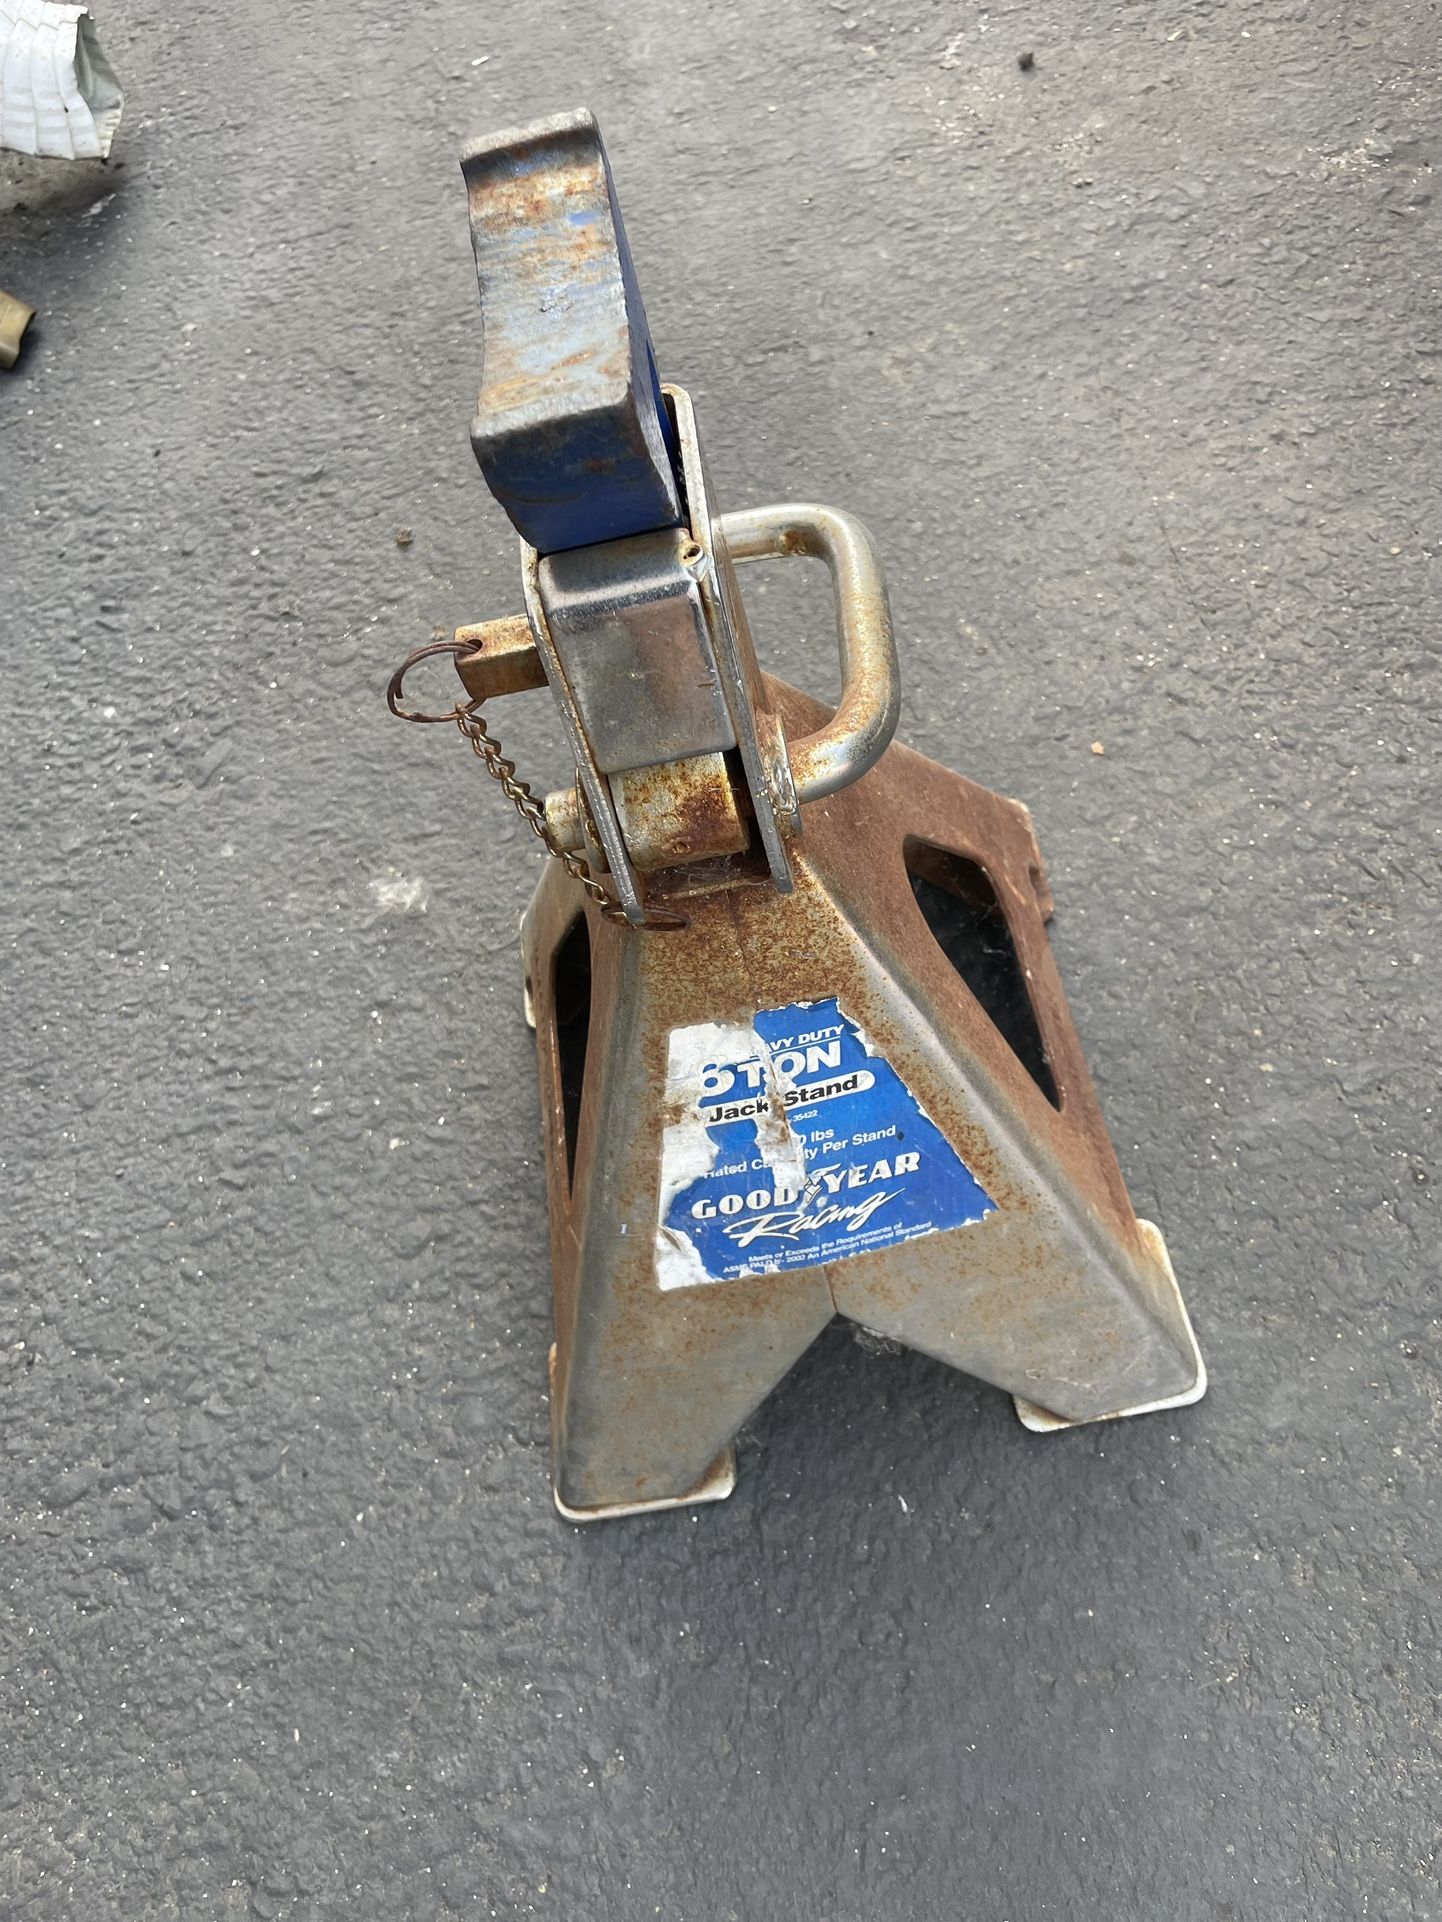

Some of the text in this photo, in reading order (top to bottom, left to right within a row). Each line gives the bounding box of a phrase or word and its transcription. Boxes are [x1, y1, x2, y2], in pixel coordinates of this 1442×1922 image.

[798, 1024, 845, 1044] DUTY
[709, 1075, 858, 1122] Jack Stand
[811, 1128, 835, 1143] lbs
[822, 1138, 849, 1154] Per
[852, 1125, 896, 1146] Stand
[722, 1188, 906, 1248] Racing
[748, 1254, 773, 1263] Meets
[786, 1246, 819, 1256] Exceeds
[821, 1241, 835, 1249] the
[836, 1226, 892, 1245] Requirements
[894, 1222, 903, 1230] of
[807, 1252, 820, 1260] An
[821, 1241, 859, 1254] American
[861, 1232, 894, 1245] National
[895, 1221, 932, 1235] Standard
